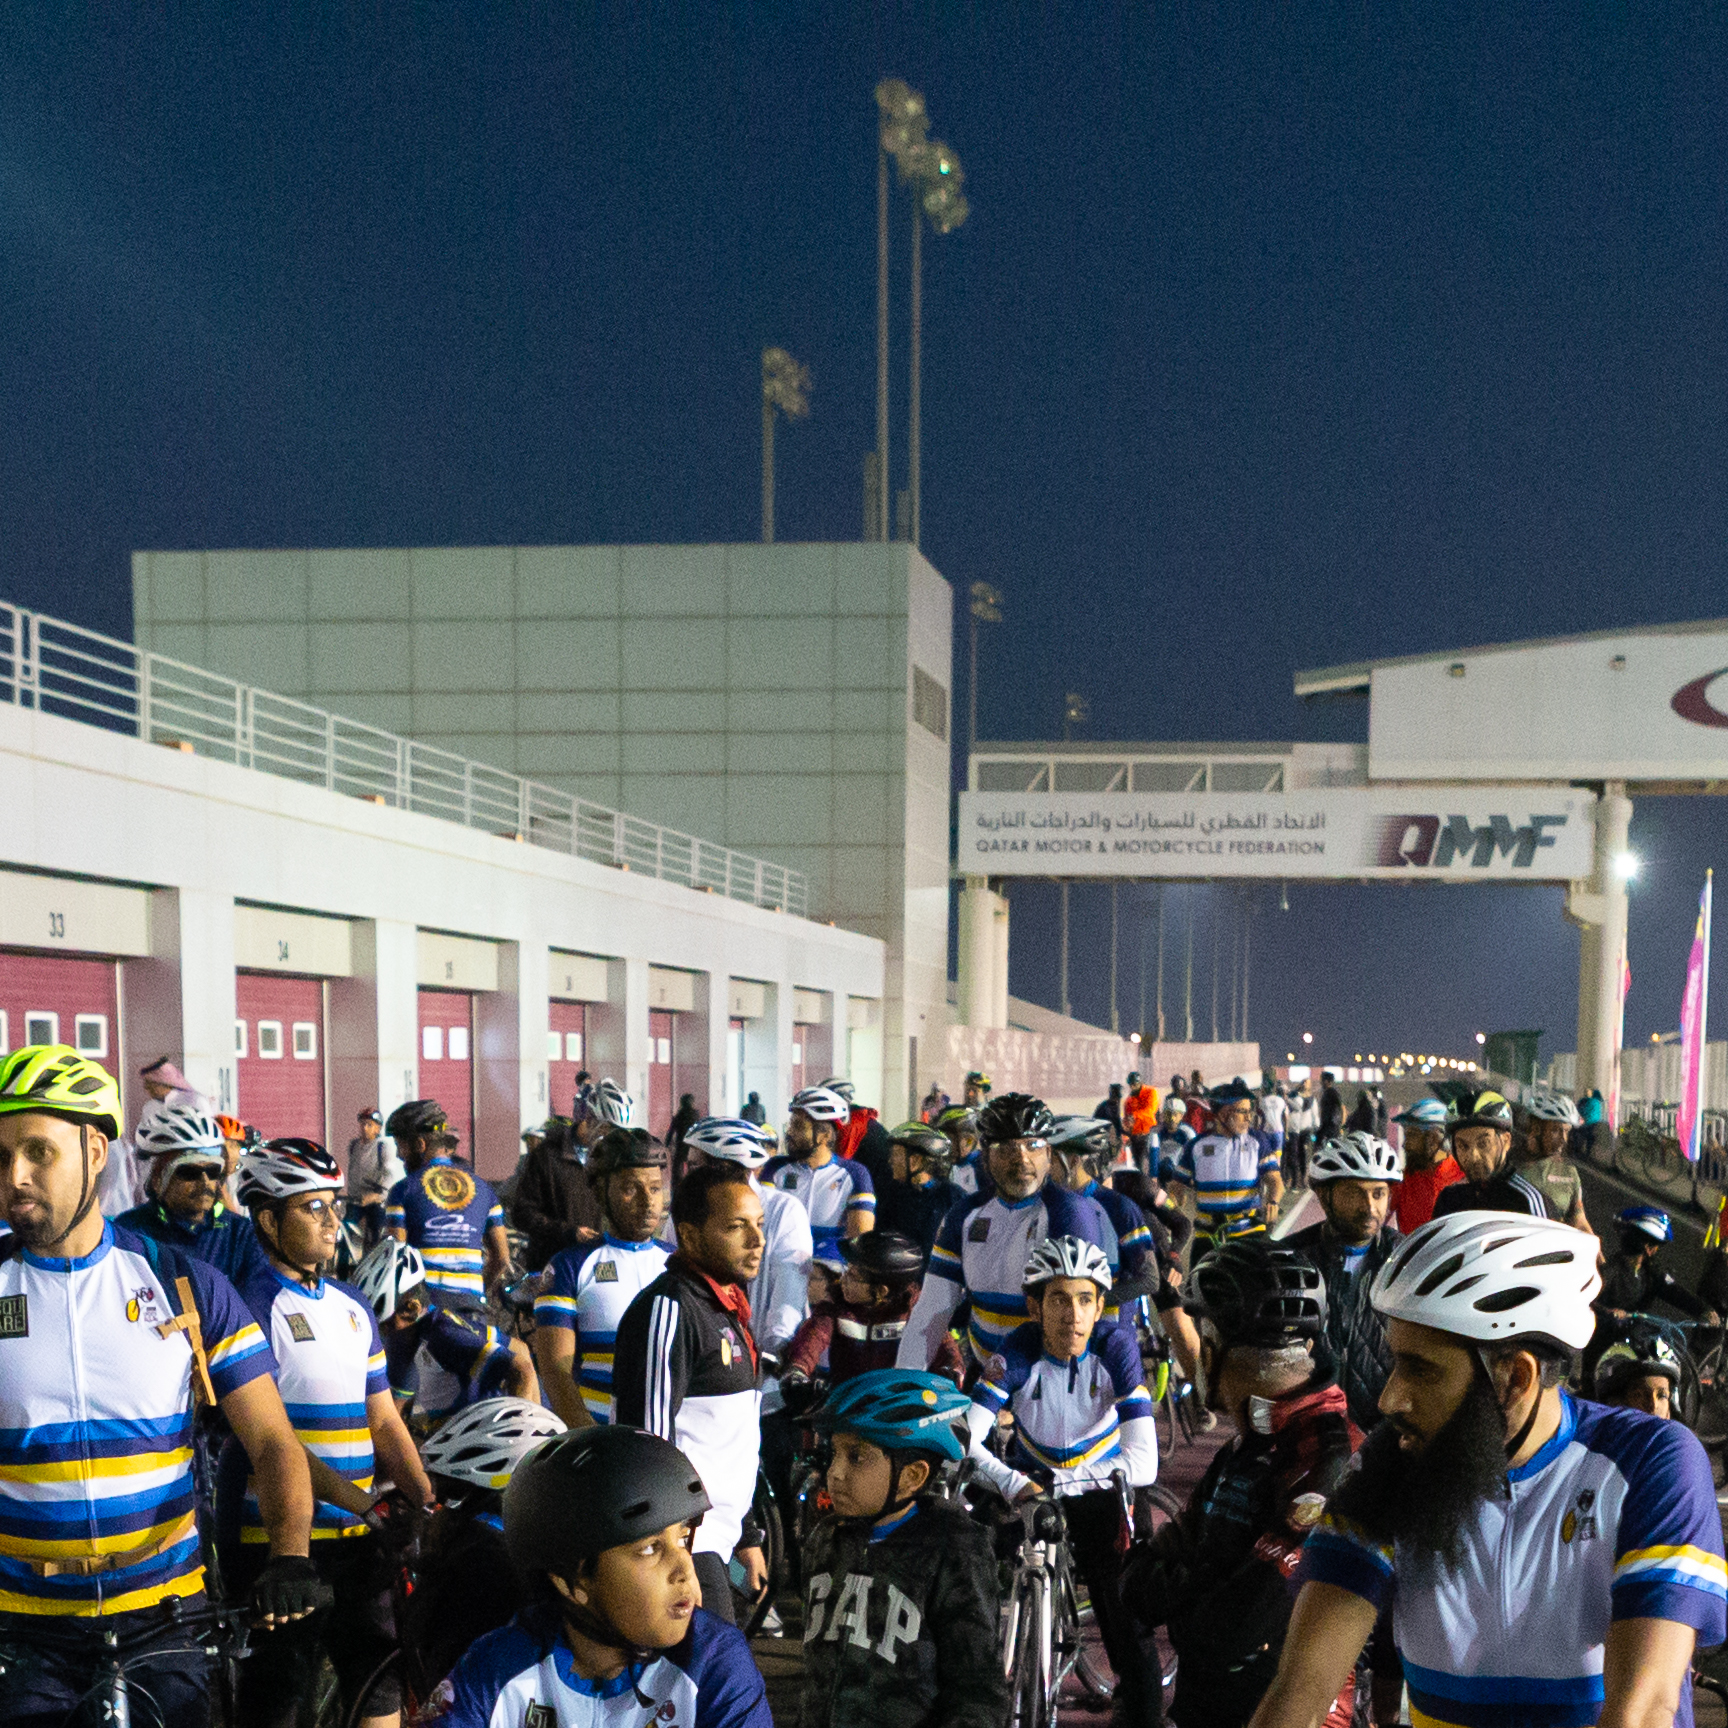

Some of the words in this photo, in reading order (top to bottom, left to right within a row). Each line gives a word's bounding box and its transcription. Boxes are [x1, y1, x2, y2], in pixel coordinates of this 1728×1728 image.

[975, 839, 1029, 854] QATAR
[1035, 839, 1092, 854] MOTOR
[1098, 840, 1108, 853] &
[1113, 839, 1223, 855] MOTORCYCLE
[1228, 839, 1326, 856] FEDERATION
[48, 911, 66, 939] 33
